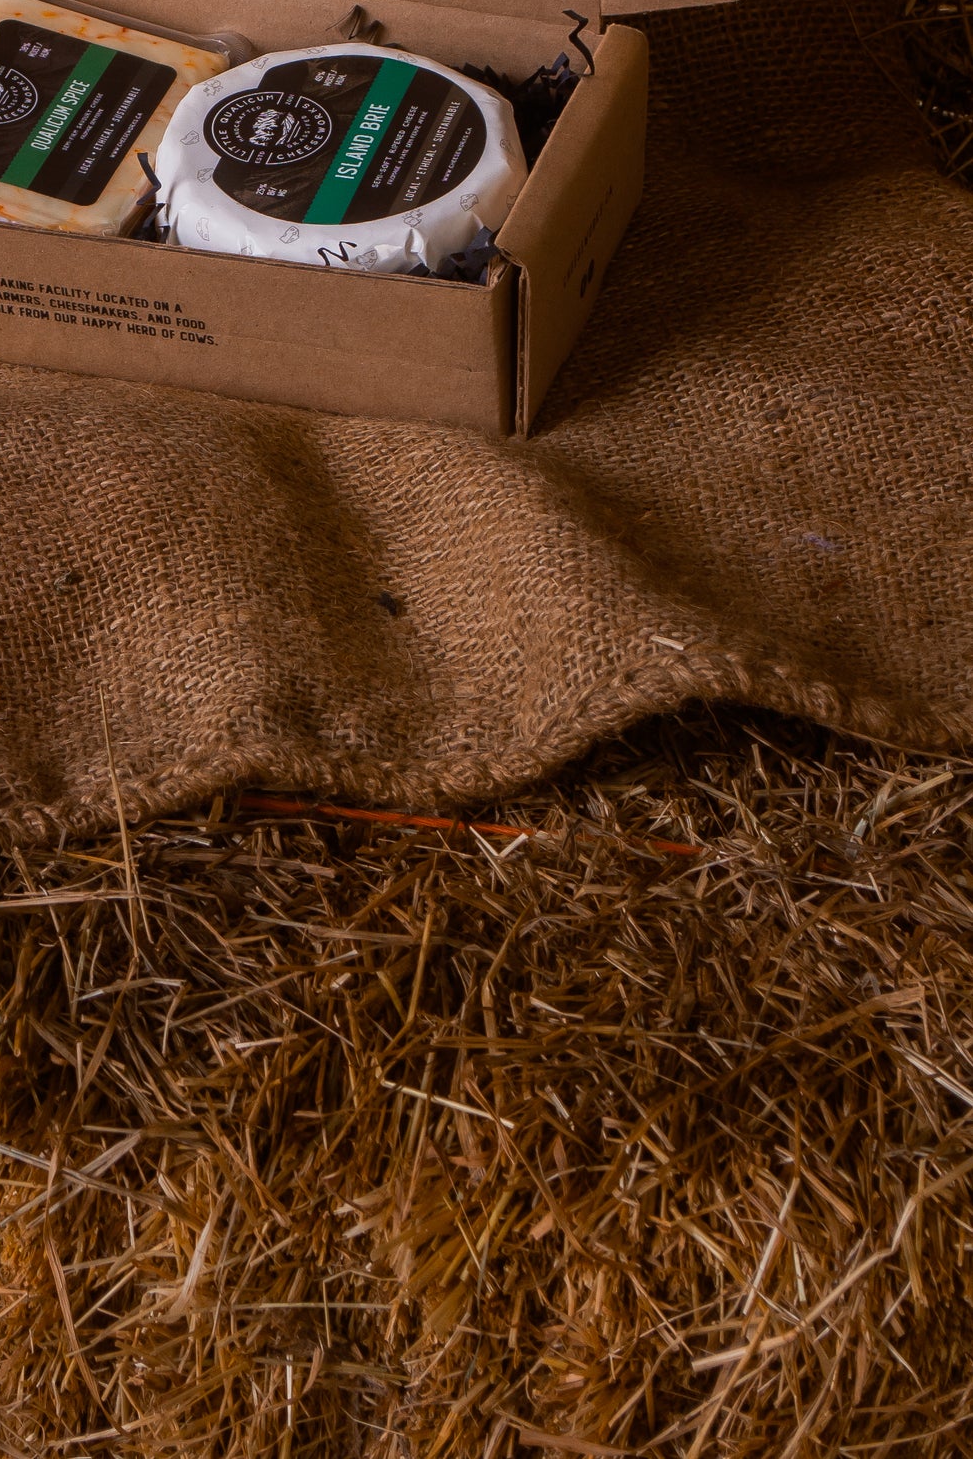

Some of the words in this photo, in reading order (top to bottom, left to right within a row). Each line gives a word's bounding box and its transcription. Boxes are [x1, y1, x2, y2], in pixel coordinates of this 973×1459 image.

[31, 104, 73, 151] QUALICUM
[61, 79, 91, 106] SPICE
[78, 156, 95, 175] LOCAL
[93, 128, 114, 151] ETHICAL
[111, 86, 141, 123] SUSTAINABLE
[220, 94, 274, 124] QUALICUM
[276, 103, 326, 160] CHEESEWORKS
[218, 130, 246, 157] LITTLE
[335, 134, 375, 180] ISLAND
[360, 103, 391, 131] BRIE
[371, 156, 393, 189] SEMI-SOFT
[388, 129, 406, 154] RIPENED
[402, 105, 419, 128] CHEESE
[403, 180, 421, 202] LOCAL
[417, 149, 438, 175] ETHICAL
[433, 101, 461, 143] SUSTAINABLE
[19, 307, 50, 321] FROM
[54, 313, 77, 324] OUR
[82, 316, 122, 331] HAPPY
[127, 324, 157, 337] HERD
[161, 329, 176, 339] OF
[180, 331, 219, 346] COWS.
[39, 283, 91, 300] FACILITY
[96, 292, 149, 308] LOCATED
[153, 300, 170, 311] ON
[174, 303, 182, 313] A
[147, 313, 172, 325] AND
[176, 317, 206, 330] FOOD
